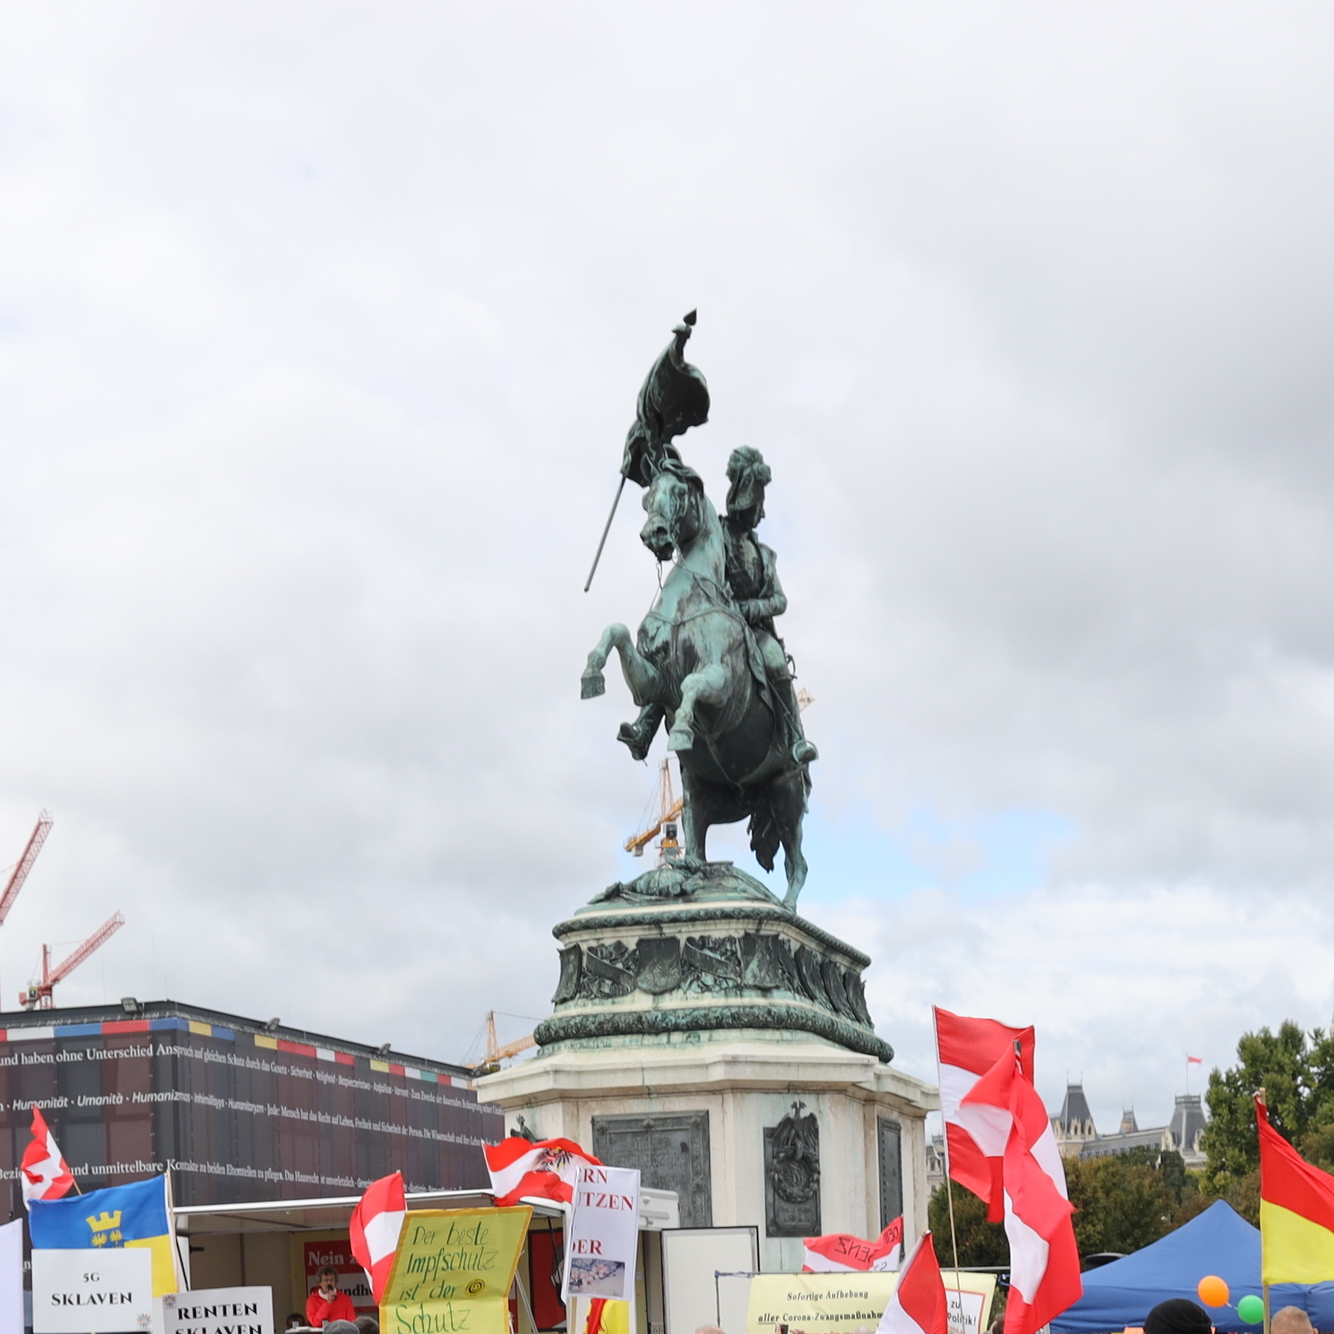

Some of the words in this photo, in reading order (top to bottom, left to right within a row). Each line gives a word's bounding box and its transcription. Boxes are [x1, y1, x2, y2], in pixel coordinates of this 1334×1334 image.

[412, 1225, 437, 1246] Der
[446, 1220, 490, 1247] beste
[308, 1250, 345, 1266] Nein
[406, 1246, 500, 1286] Impfschutz
[82, 1272, 101, 1283] 5G
[428, 1280, 463, 1299] der
[786, 1290, 824, 1301] Sofortige
[825, 1289, 870, 1301] Aufhebung
[50, 1292, 133, 1307] SKLAVEN
[177, 1303, 259, 1321] RENTEN
[758, 1312, 780, 1323] aller
